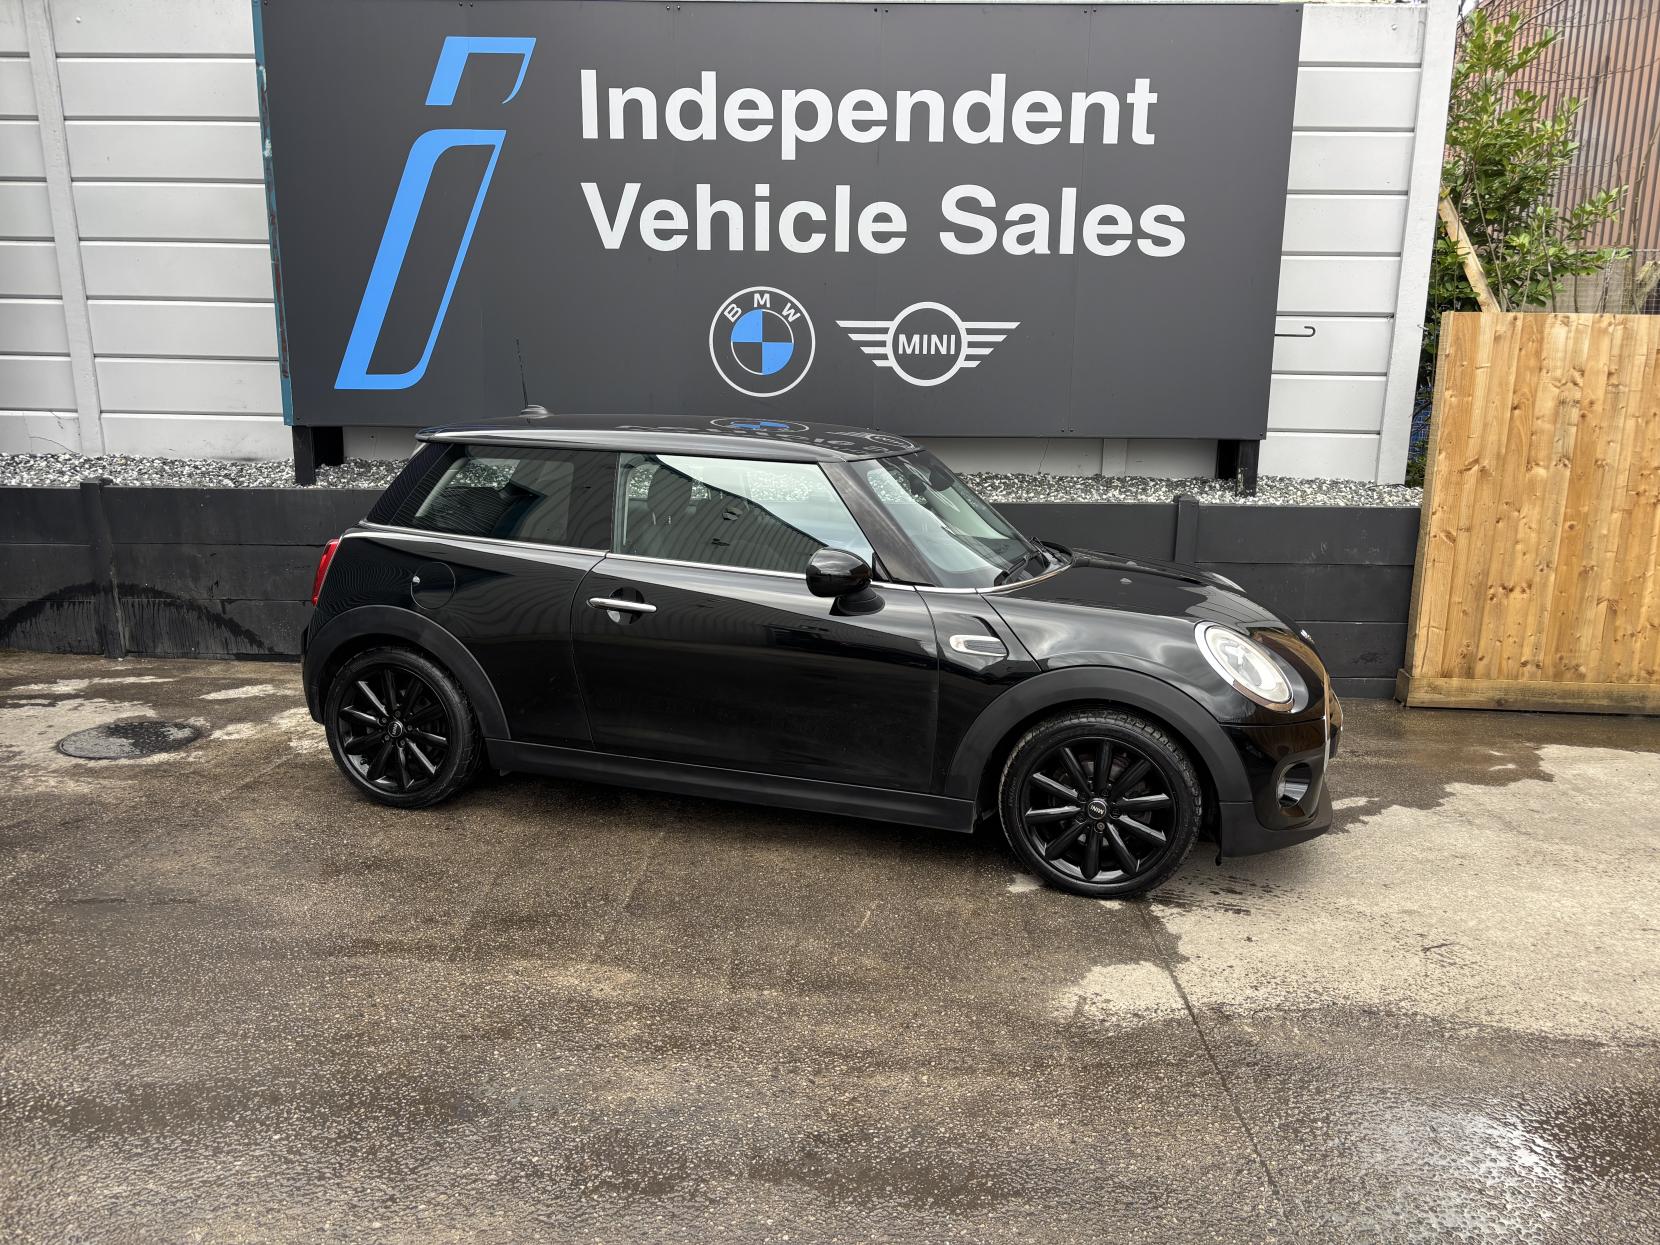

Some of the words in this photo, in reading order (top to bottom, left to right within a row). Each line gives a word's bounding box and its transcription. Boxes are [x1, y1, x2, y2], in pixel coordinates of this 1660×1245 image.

[580, 69, 1159, 161] Independent
[580, 182, 908, 255] Vehicle
[939, 184, 1186, 258] Sales
[723, 292, 801, 323] BMW
[898, 333, 956, 355] MINI
